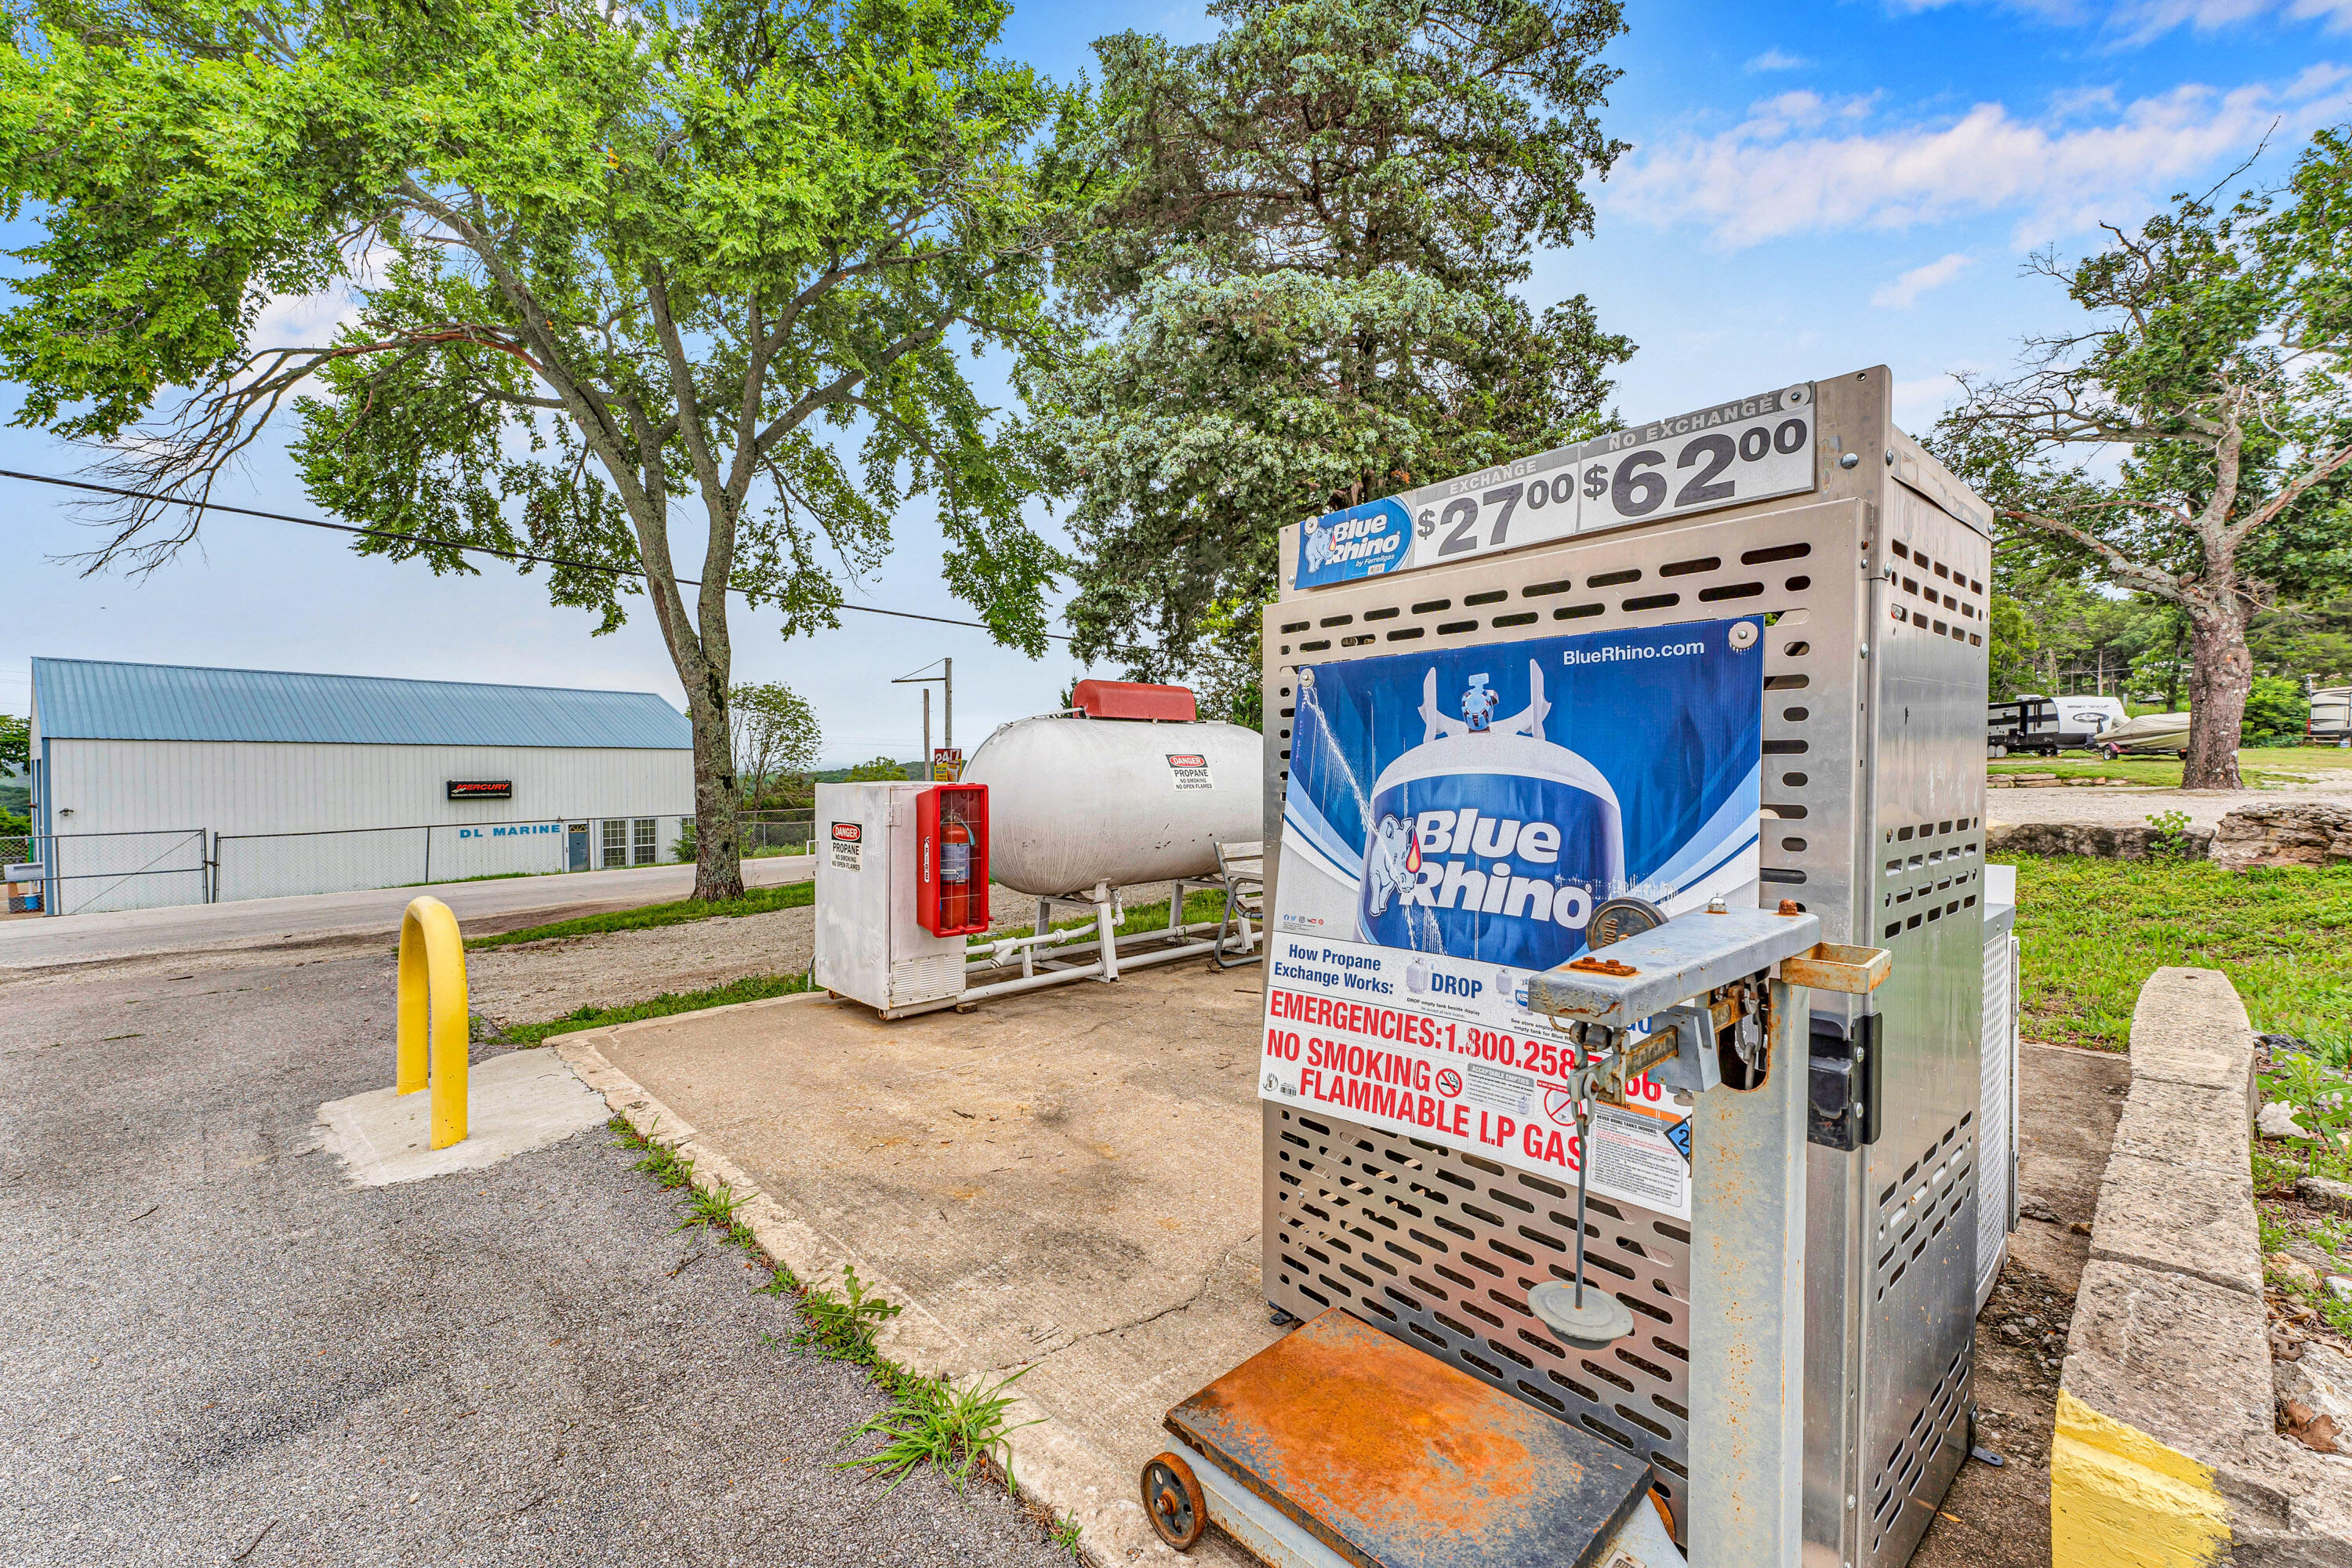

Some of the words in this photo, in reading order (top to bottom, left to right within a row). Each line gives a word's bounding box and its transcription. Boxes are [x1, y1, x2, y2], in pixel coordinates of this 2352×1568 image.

[1609, 434, 1636, 452] NO
[1646, 397, 1773, 441] EXCHANGE
[1450, 459, 1537, 495] EXCHANGE
[1333, 514, 1388, 543] Blue
[1325, 533, 1400, 566] Rhino
[1355, 559, 1363, 568] by
[1364, 553, 1396, 565] Ferrellgas
[1563, 641, 1705, 666] BlueRhino.com
[459, 829, 483, 838] DL
[492, 824, 561, 837] MARINE
[834, 826, 858, 839] DANGER
[1415, 808, 1561, 863] Blue
[833, 842, 860, 855] PROPANE
[840, 855, 856, 863] SMOKING
[846, 862, 860, 871] FLAMES
[1398, 861, 1592, 930] Rhino
[1289, 943, 1319, 961] How
[1322, 949, 1381, 971] Propane
[1274, 961, 1339, 987] Exchange
[1344, 972, 1394, 995] Works:
[1431, 972, 1483, 999] DROP
[1266, 1028, 1300, 1062] NO
[1307, 1037, 1431, 1092] SMOKING
[1472, 1065, 1505, 1080] ACCEPTABLE
[1505, 1074, 1530, 1085] EMPTIES
[1300, 1067, 1470, 1138] FLAMMABLE
[1523, 1123, 1588, 1172] GAS
[1610, 1117, 1623, 1126] BRING
[1624, 1120, 1637, 1129] TANKS
[1638, 1124, 1657, 1134] INDOORS.
